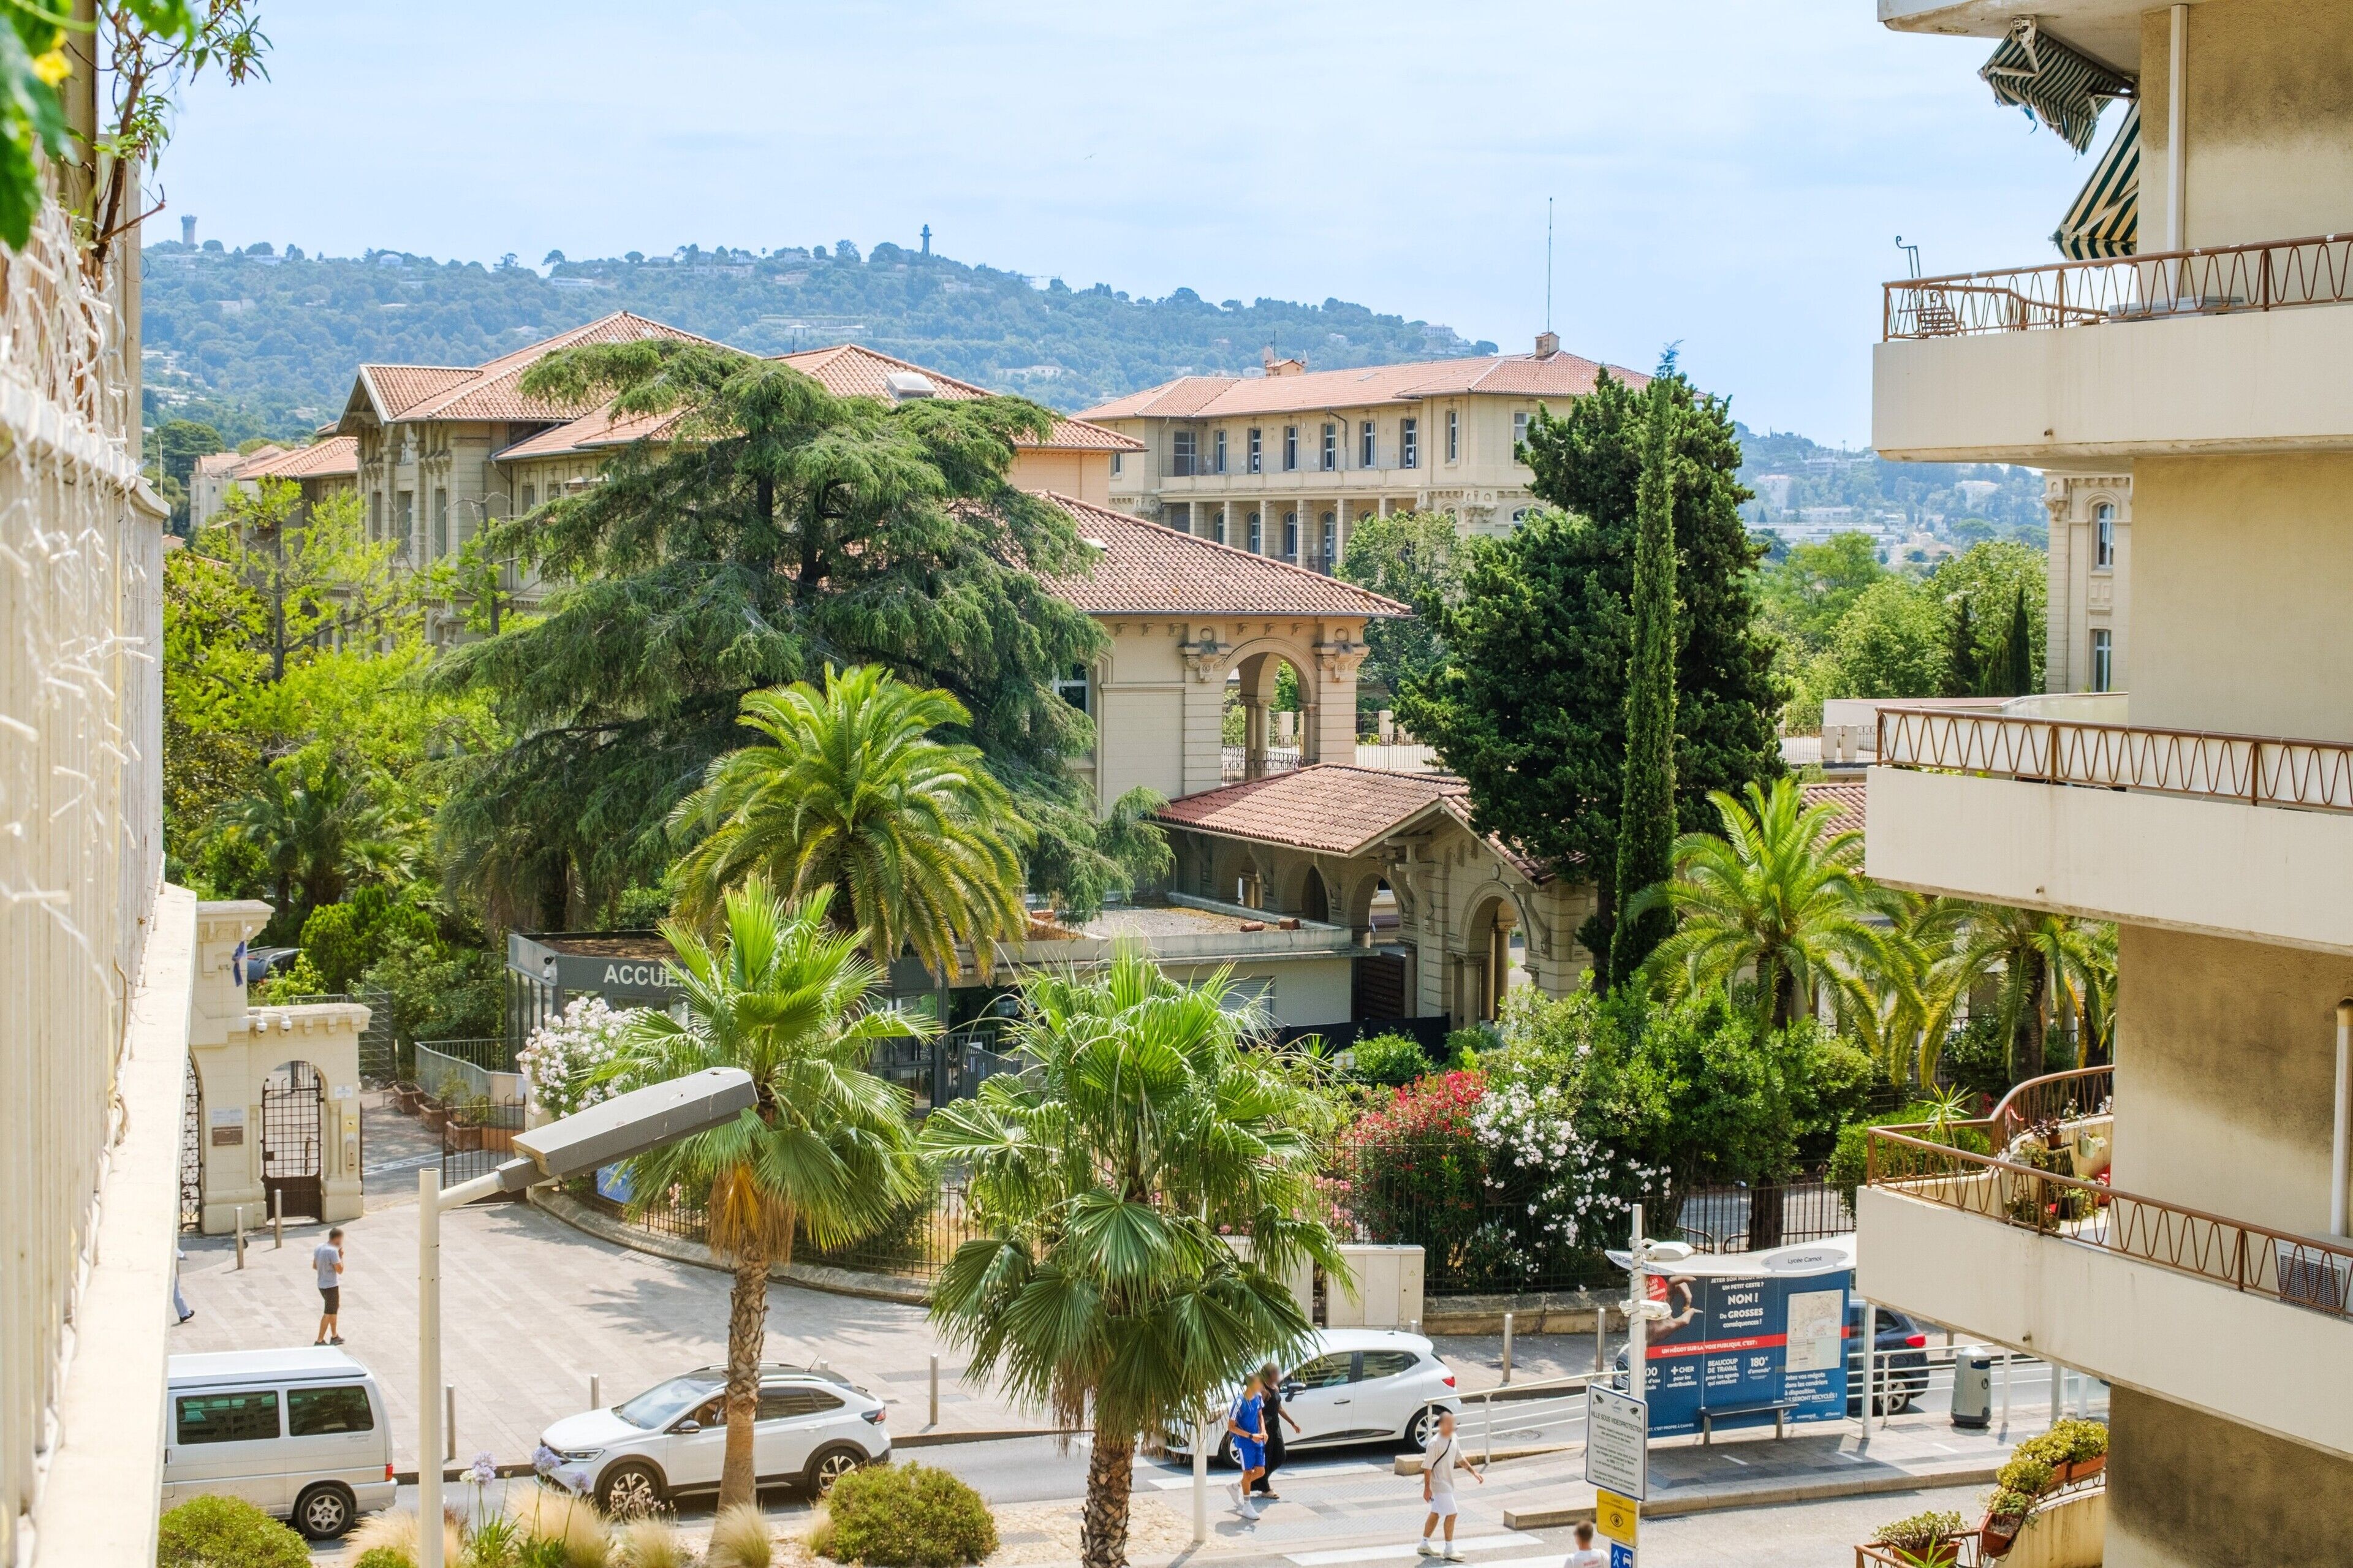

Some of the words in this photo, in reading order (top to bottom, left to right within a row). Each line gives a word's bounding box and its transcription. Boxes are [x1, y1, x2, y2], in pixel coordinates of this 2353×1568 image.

[604, 964, 685, 987] ACCUE
[1622, 1257, 1633, 1265] Carno
[1728, 1293, 1752, 1305] NON
[1754, 1292, 1759, 1303] !
[1727, 1308, 1764, 1319] GROSSES
[1722, 1320, 1759, 1328] conséquences
[1708, 1358, 1738, 1366] BEAUCOUP
[1645, 1366, 1658, 1377] 00
[1811, 1392, 1835, 1401] RECYCLÉS
[1591, 1411, 1600, 1419] VILLE
[1601, 1414, 1610, 1422] SOUS
